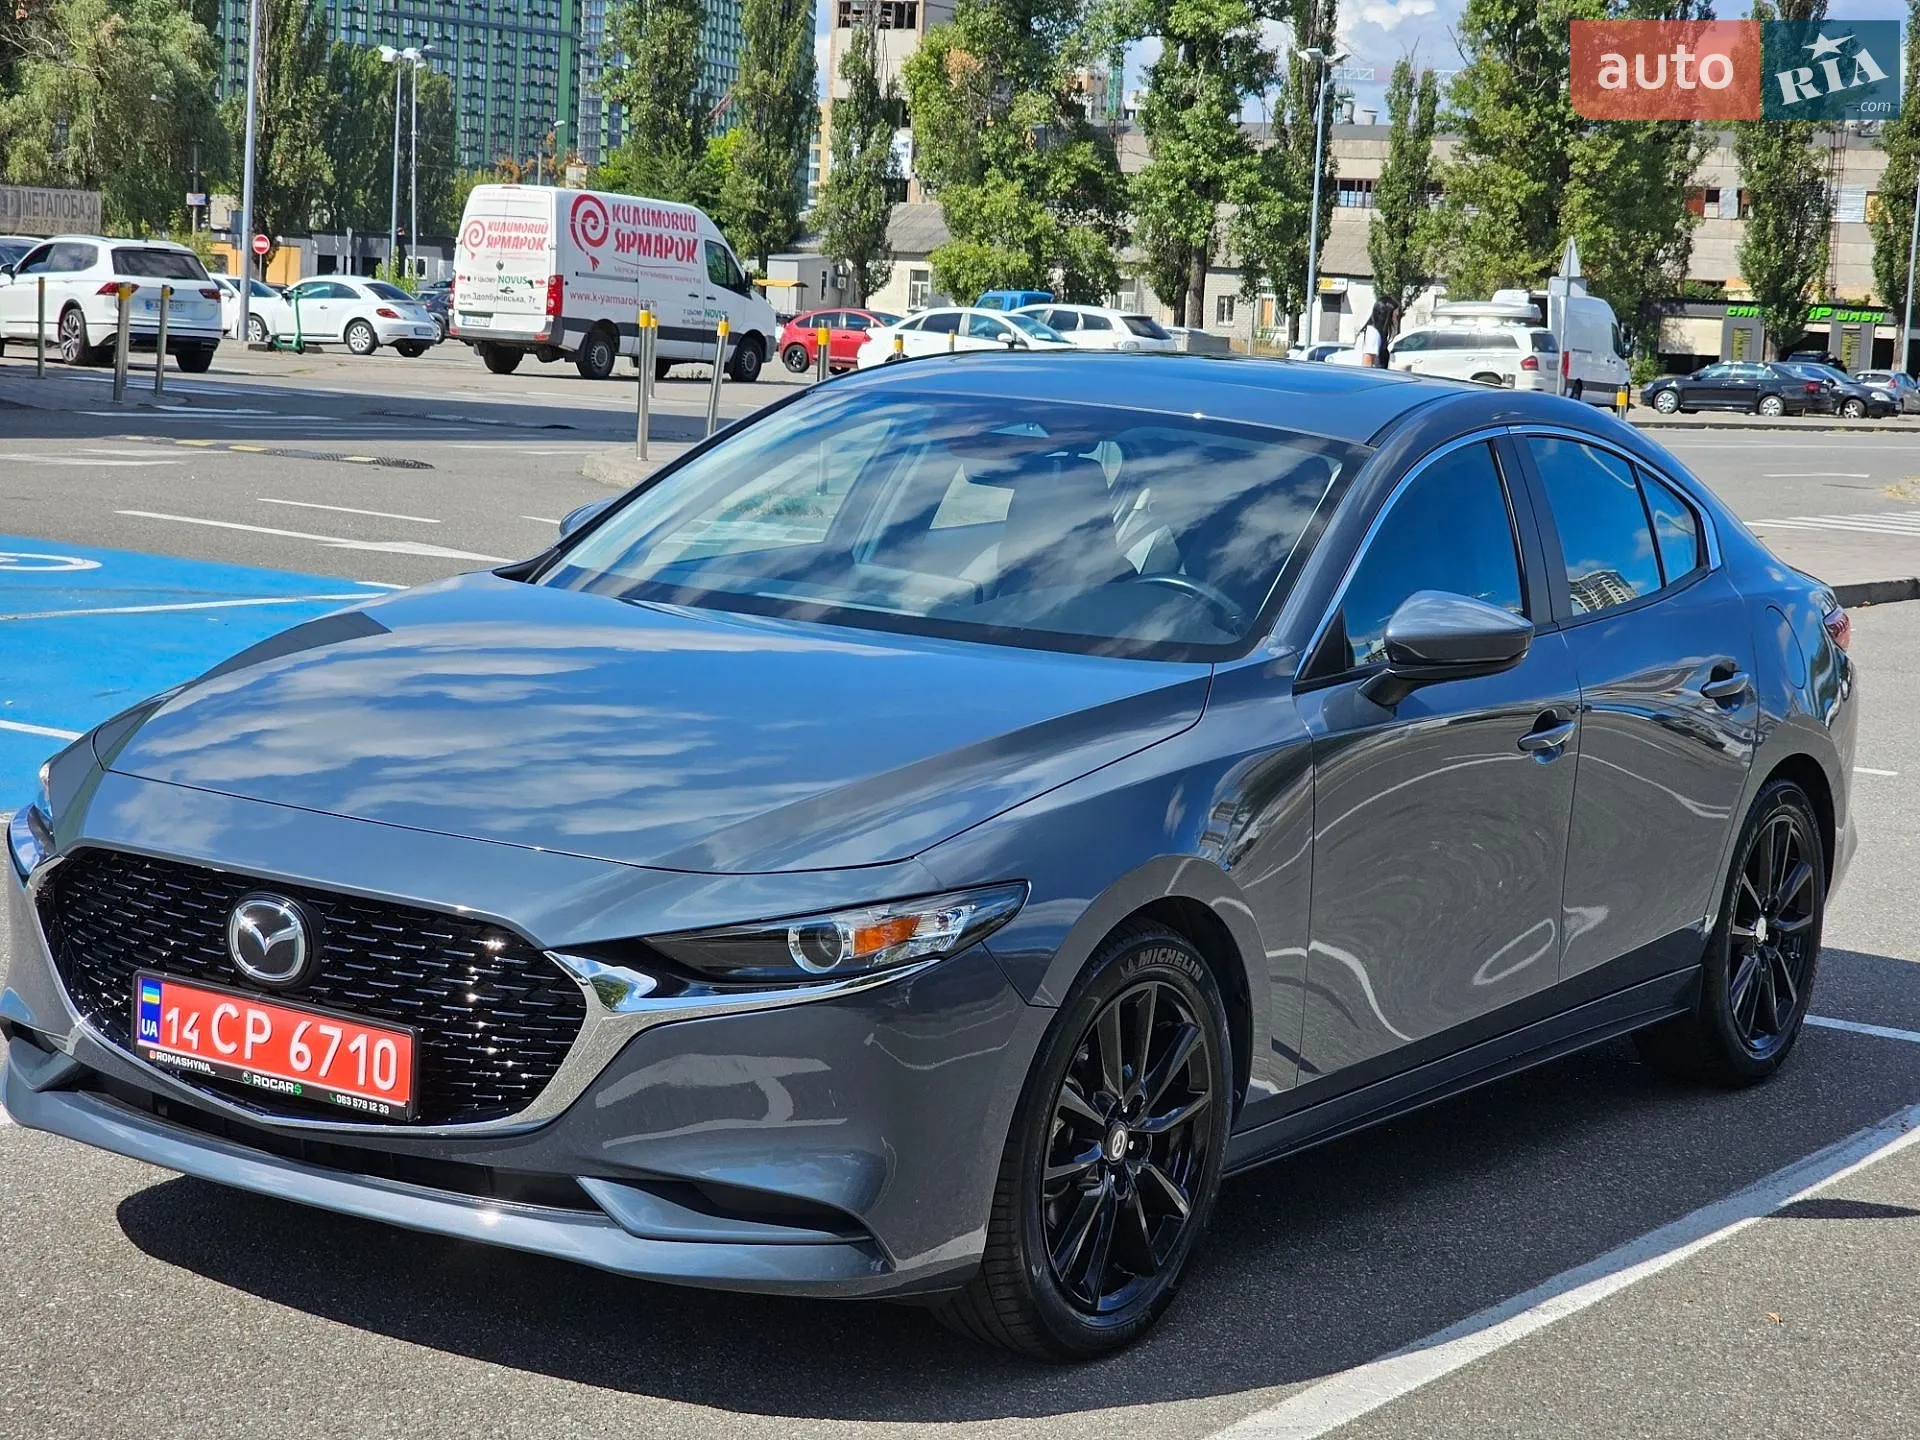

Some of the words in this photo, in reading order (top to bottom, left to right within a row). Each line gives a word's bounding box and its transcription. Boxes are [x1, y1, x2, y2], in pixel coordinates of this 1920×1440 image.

[22, 190, 99, 219] МЕТАЛОБАЗА
[486, 234, 547, 252] ЯРМАРОК
[614, 228, 698, 265] ЯРМАРОК
[498, 274, 528, 285] NOVUS
[1836, 313, 1884, 322] WASH
[1137, 947, 1204, 982] MICHELIN
[141, 1018, 158, 1038] UA
[165, 1007, 200, 1050] 14
[211, 1002, 273, 1060] CP
[289, 1020, 397, 1091] 6710
[336, 1094, 352, 1106] 063
[352, 1097, 368, 1110] 579
[368, 1101, 378, 1112] 12
[378, 1103, 390, 1115] 33
